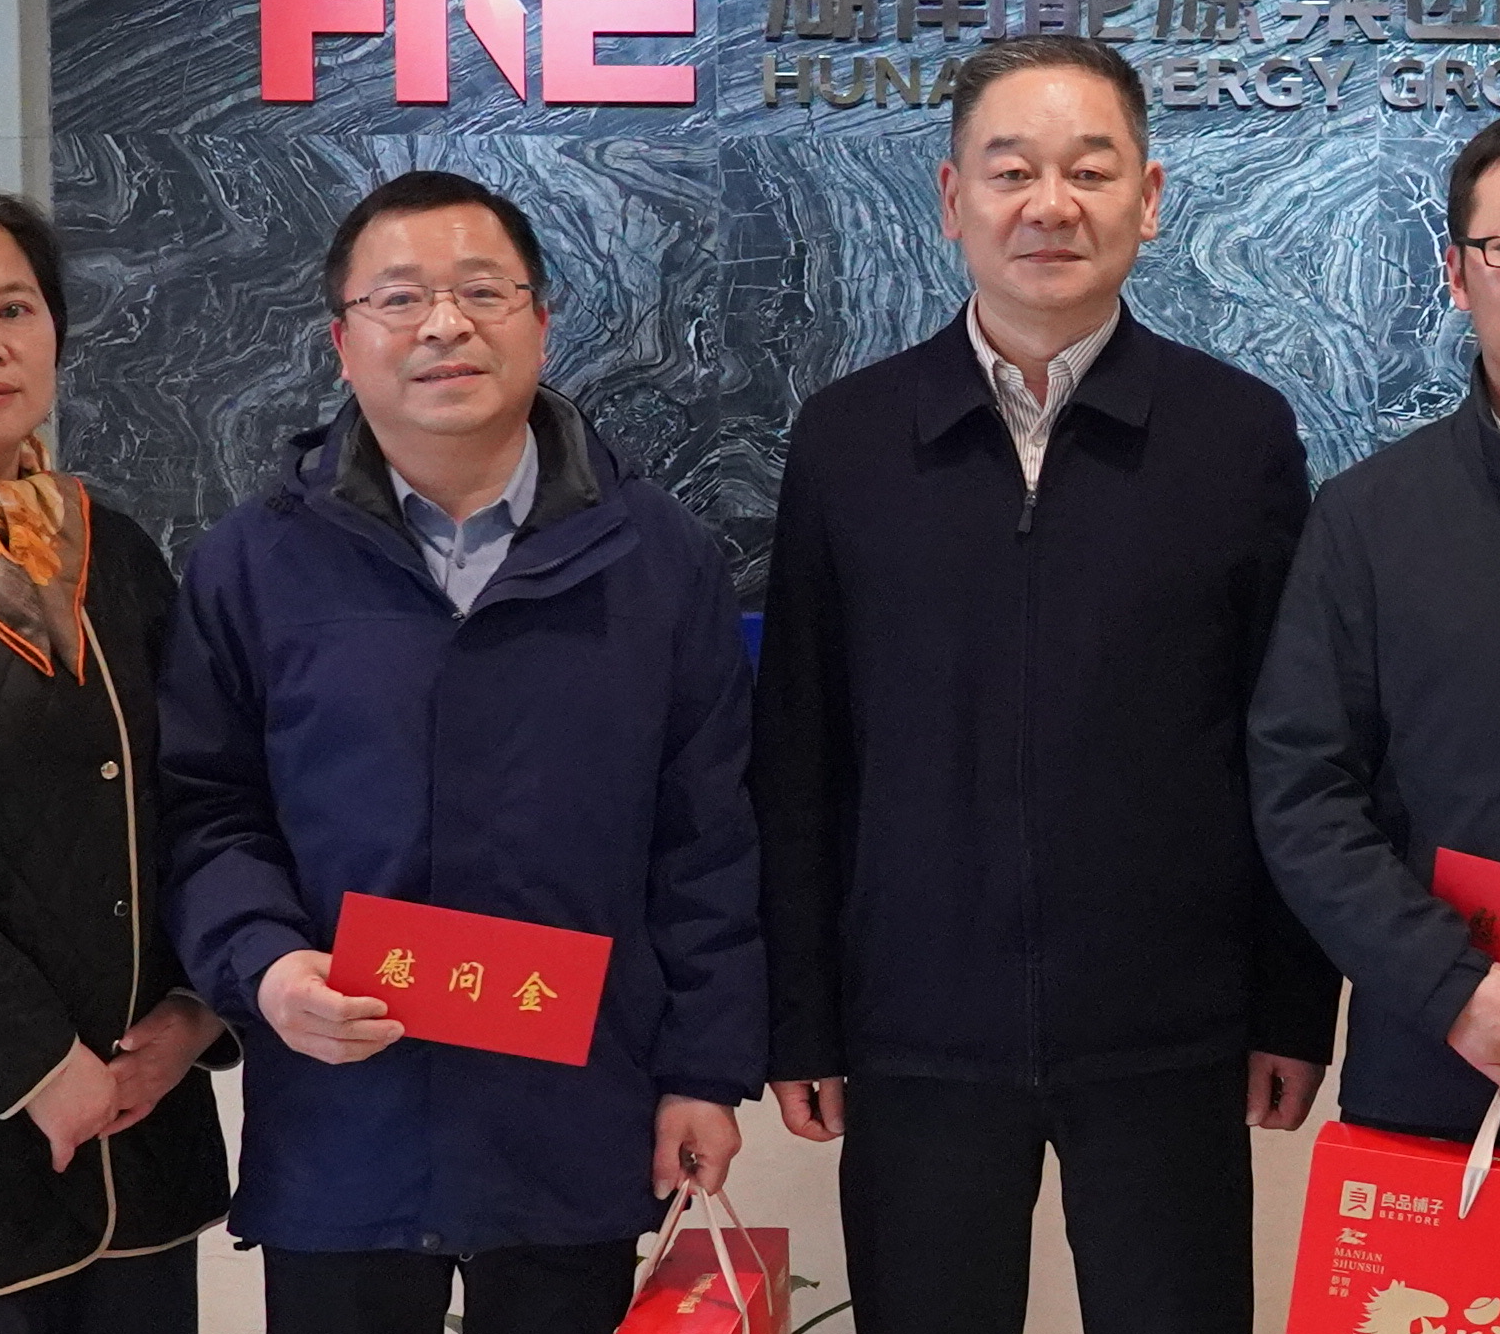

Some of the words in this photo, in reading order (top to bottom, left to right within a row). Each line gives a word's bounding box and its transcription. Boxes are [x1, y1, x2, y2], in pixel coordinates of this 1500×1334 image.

[762, 54, 962, 109] HUNA
[1140, 55, 1355, 111] ERGY
[375, 948, 559, 1012] 慰问金
[1379, 1209, 1441, 1227] BESTORE
[1331, 1258, 1386, 1275] SHUNSUI
